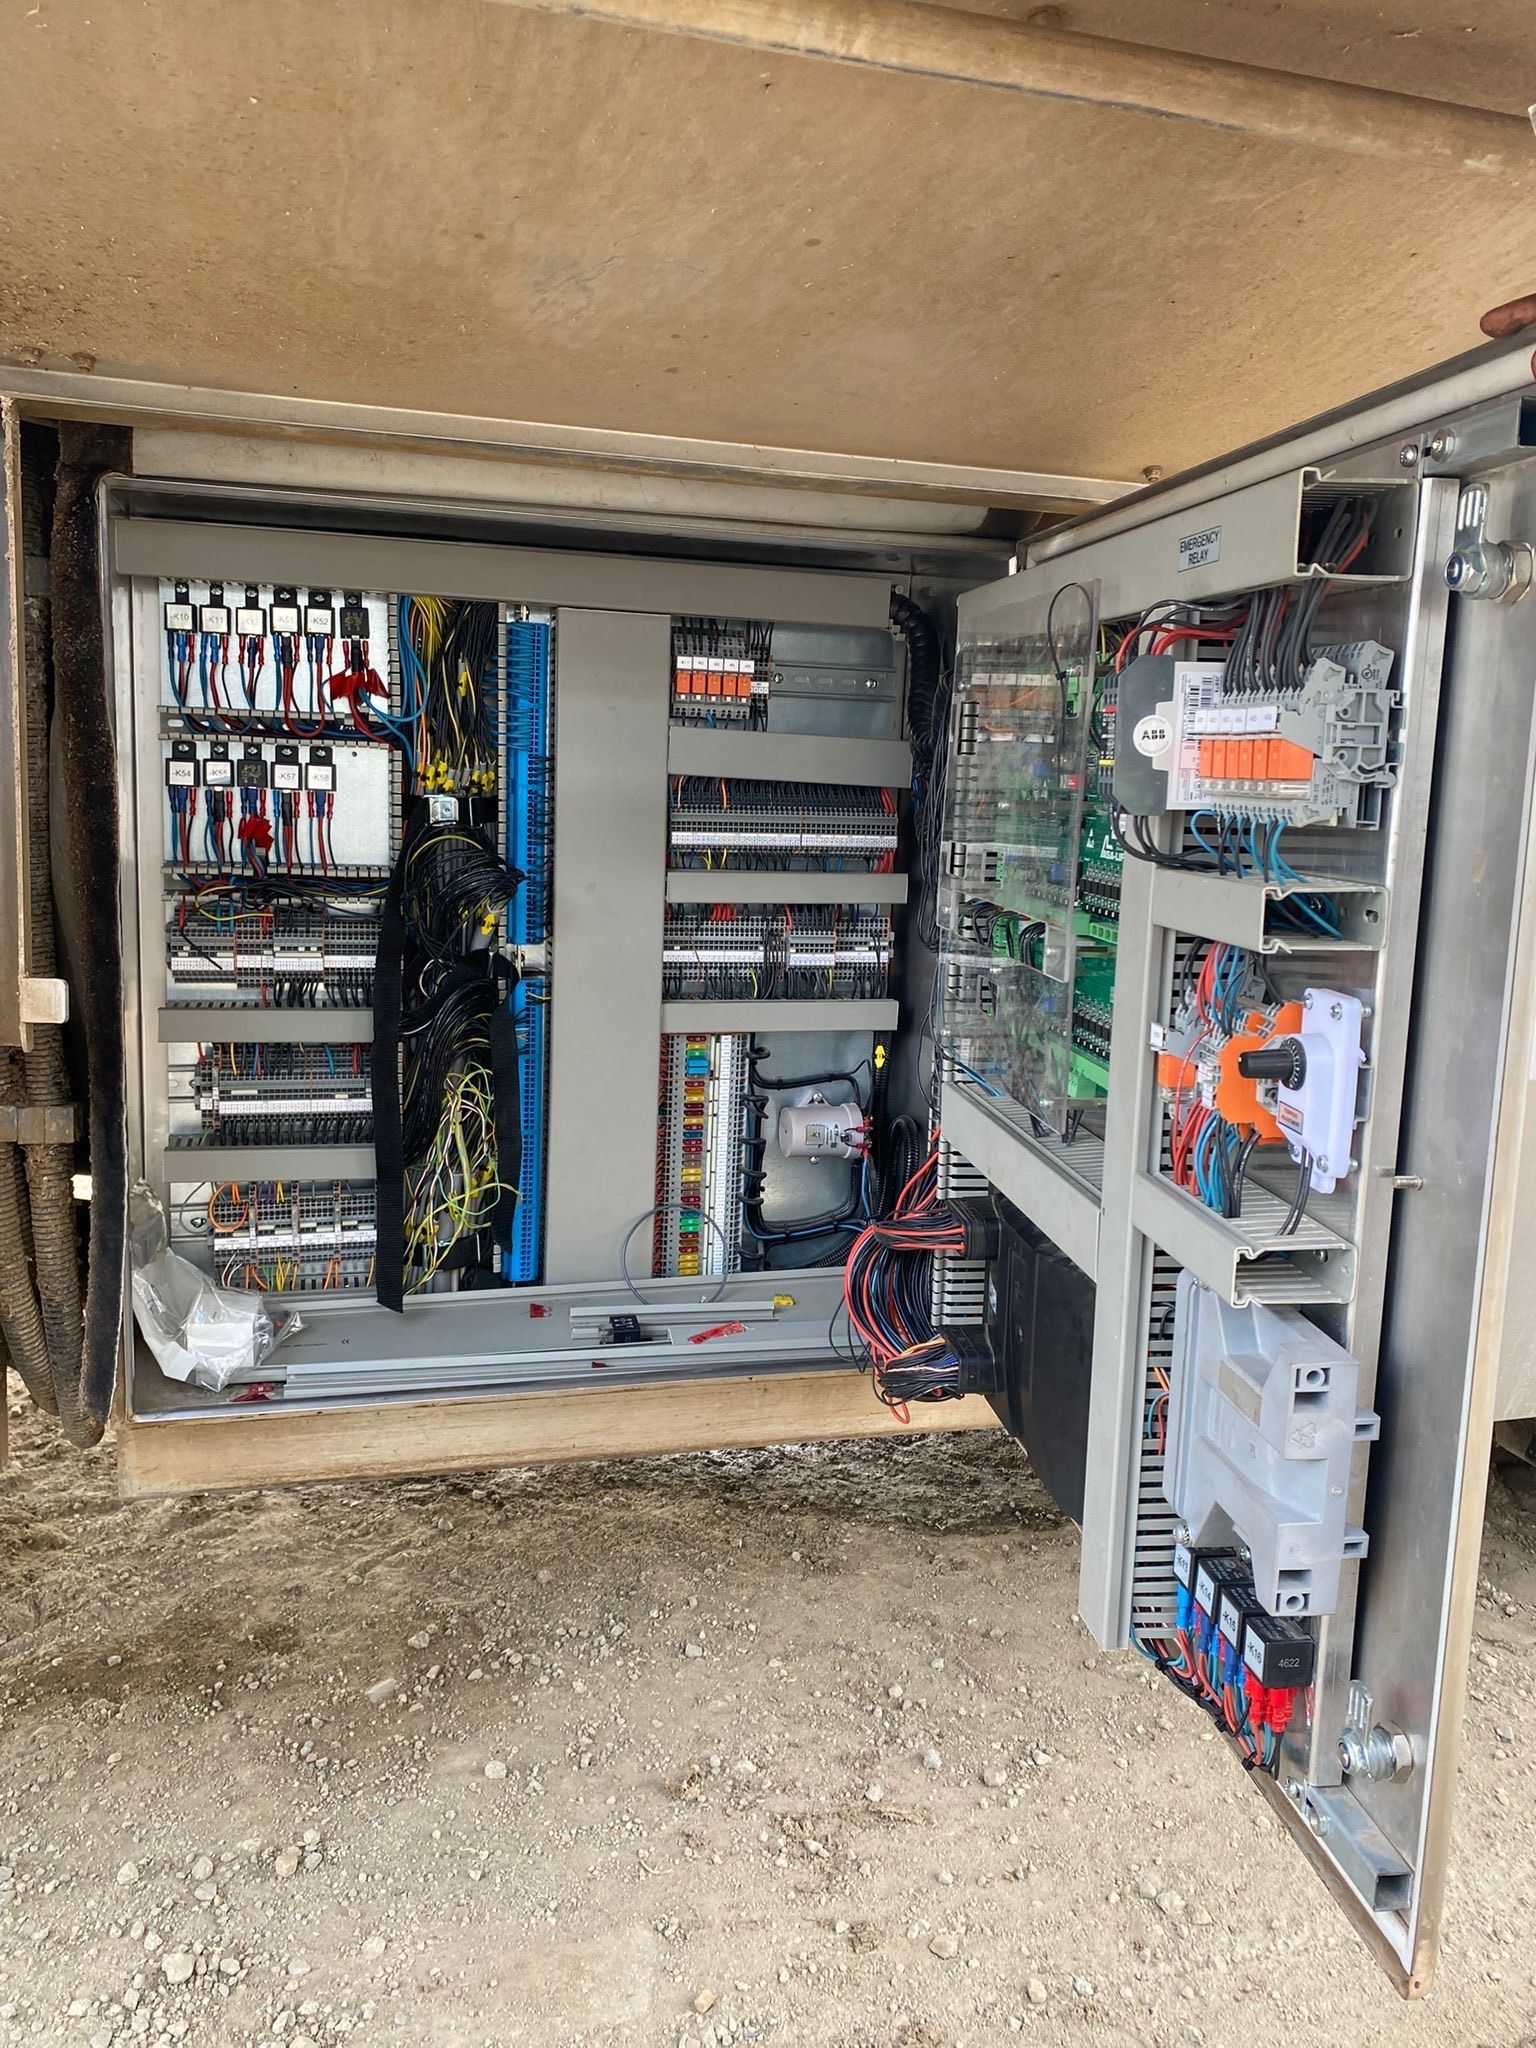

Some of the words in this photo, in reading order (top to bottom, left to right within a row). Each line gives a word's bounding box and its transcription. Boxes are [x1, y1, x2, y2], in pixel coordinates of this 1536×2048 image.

[1179, 529, 1220, 553] EMERGENCY
[1188, 549, 1209, 565] RELAY
[170, 612, 189, 621] -K10
[205, 615, 223, 624] -K11
[310, 617, 328, 626] -K52
[1141, 728, 1166, 741] ABB
[172, 769, 191, 777] -K54
[278, 773, 296, 781] -K57
[1199, 1580, 1212, 1602] -K14
[1222, 1609, 1236, 1632] -K15
[1247, 1642, 1262, 1664] -K16
[1278, 1657, 1301, 1668] 4622
